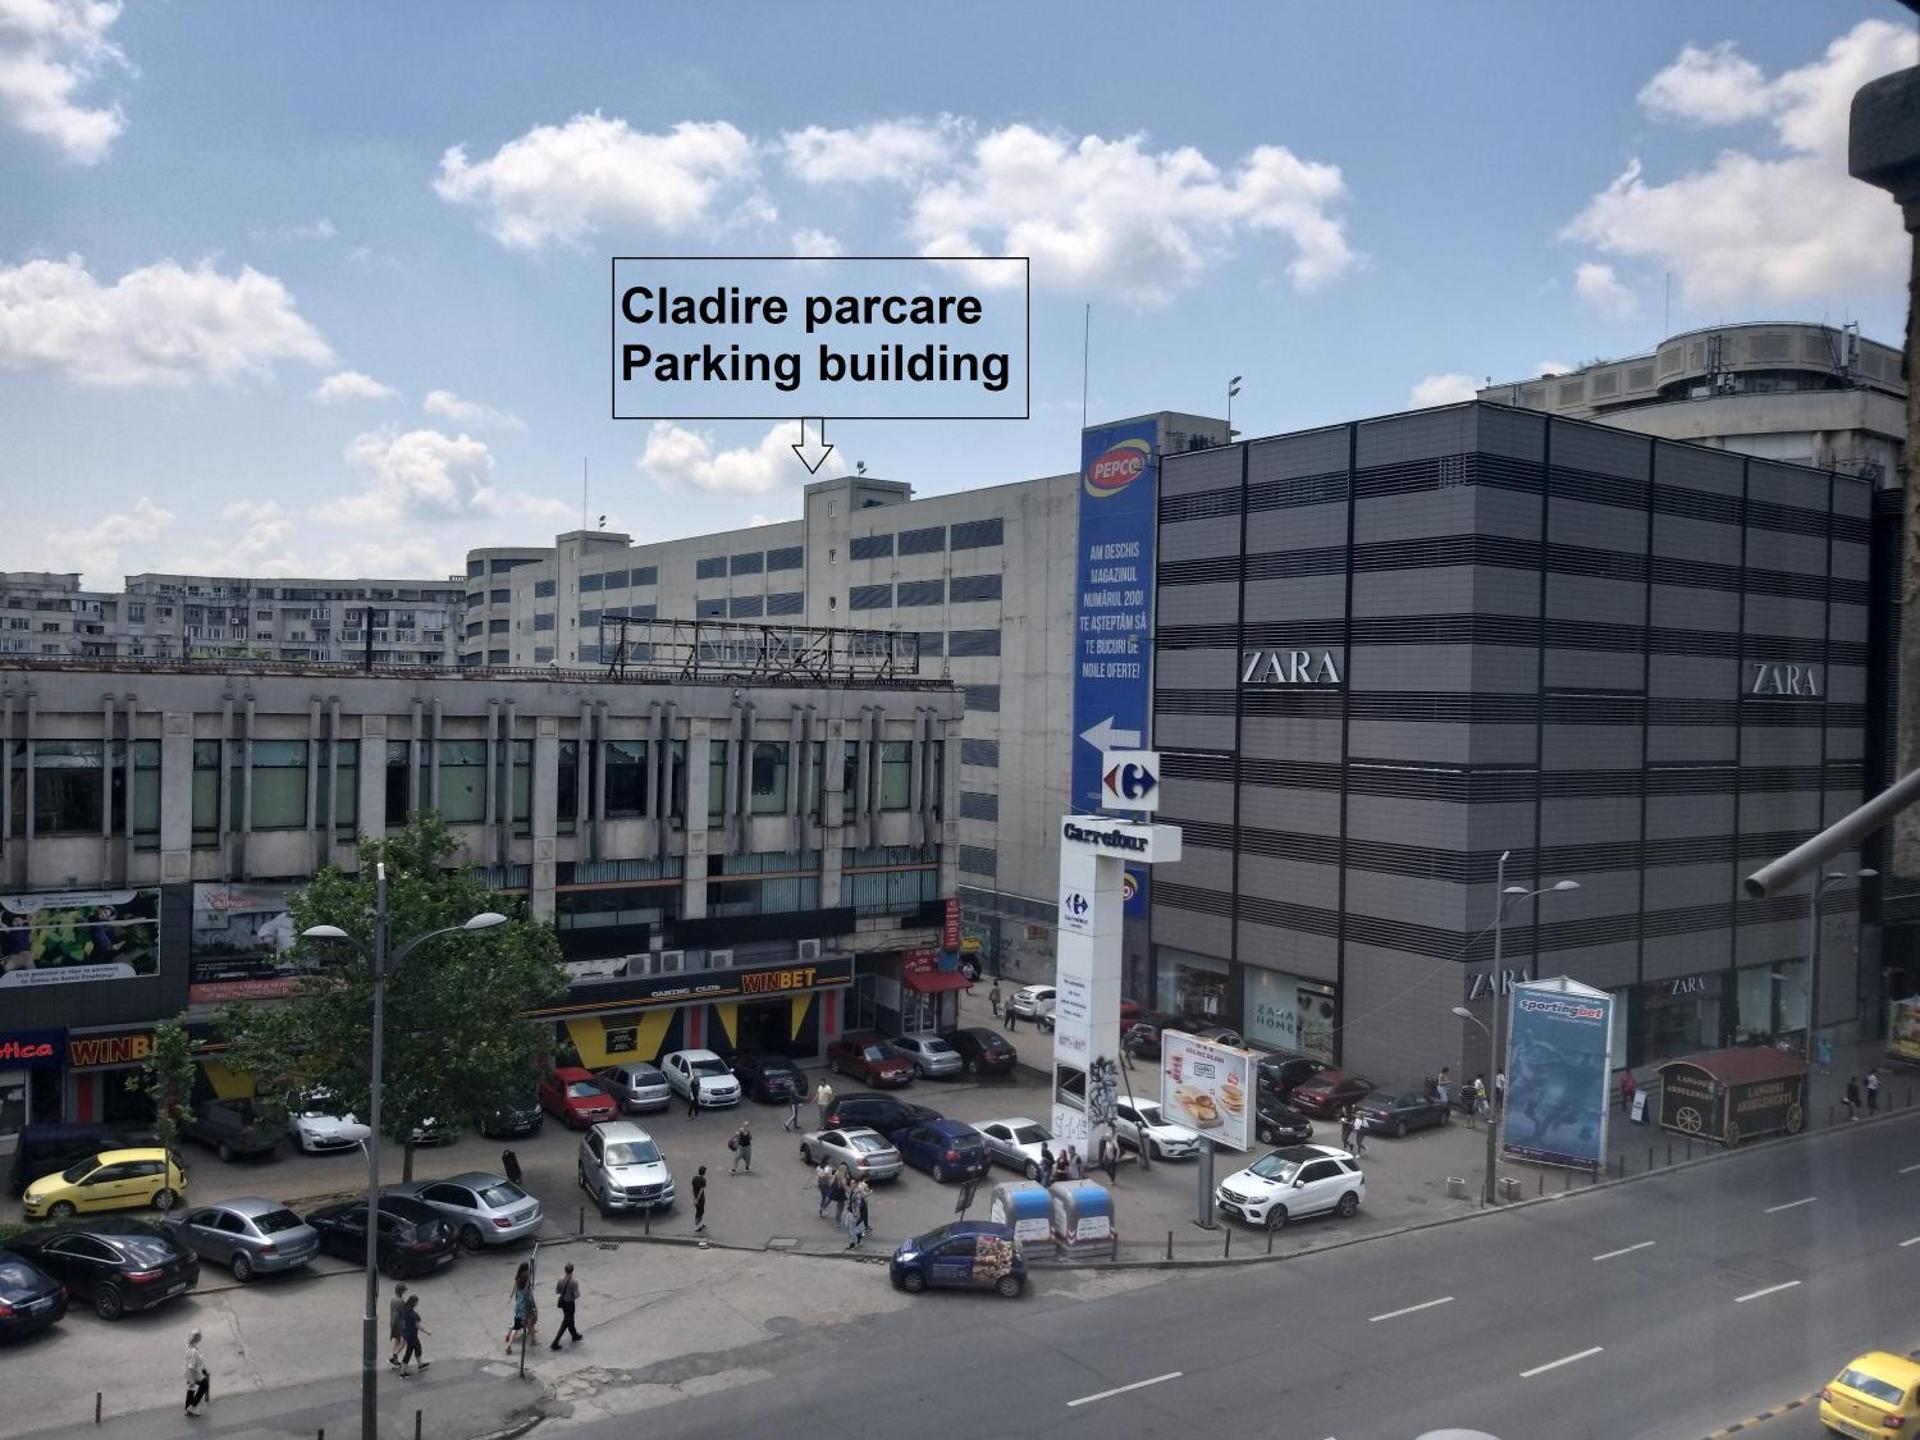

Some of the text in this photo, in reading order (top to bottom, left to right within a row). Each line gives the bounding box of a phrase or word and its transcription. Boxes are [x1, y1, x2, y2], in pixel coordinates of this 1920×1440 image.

[1094, 456, 1141, 480] PEPCO
[1090, 541, 1140, 560] AM DESCHIS
[1090, 566, 1137, 584] MAGAZINUL
[1083, 588, 1144, 608] NUMĂRUL 200!
[1080, 616, 1090, 632] TE
[1135, 611, 1147, 631] SĂ
[1086, 639, 1139, 654] TE BUCURI DE
[1083, 662, 1140, 679] NOILE OFERTE!
[1242, 650, 1340, 683] ZARA
[1752, 663, 1817, 696] ZARA
[1063, 822, 1149, 852] Carrefour
[741, 968, 816, 994] WINBET
[1671, 976, 1705, 995] ZARA
[651, 984, 721, 998] GAMING CLUB
[1257, 1003, 1294, 1021] ZARA
[1521, 999, 1604, 1019] sportingbet
[1257, 1015, 1294, 1034] HOME
